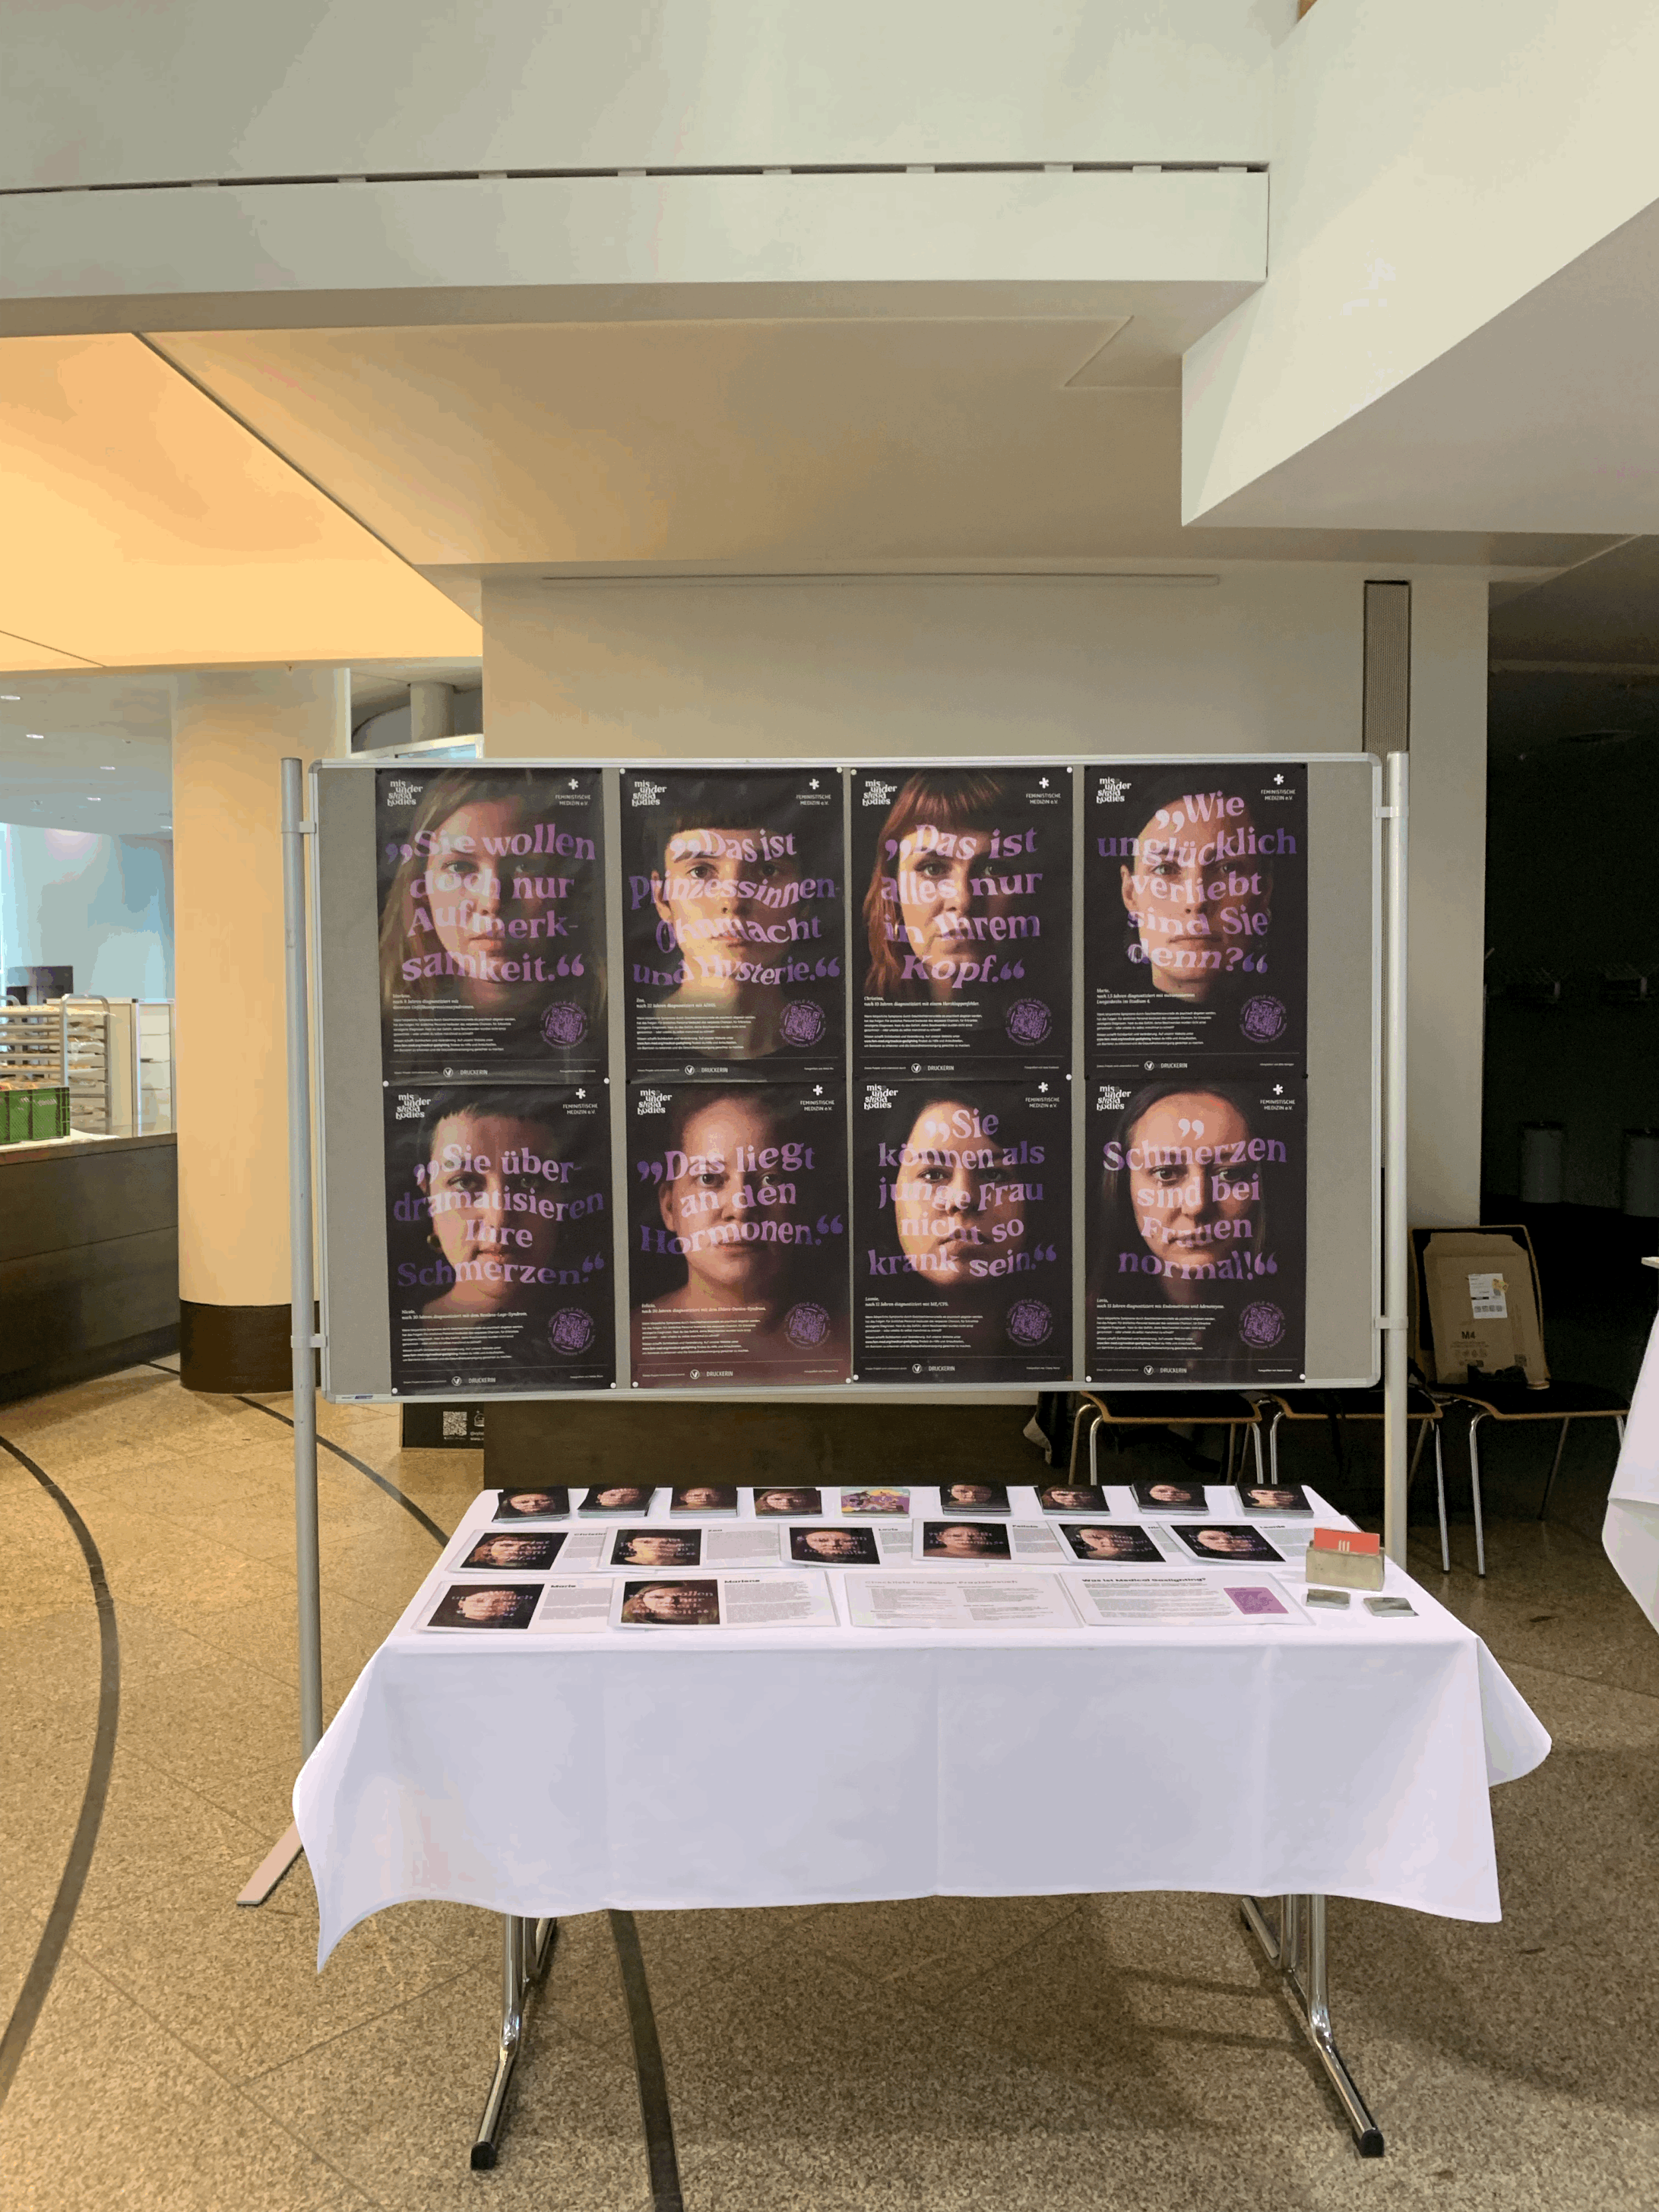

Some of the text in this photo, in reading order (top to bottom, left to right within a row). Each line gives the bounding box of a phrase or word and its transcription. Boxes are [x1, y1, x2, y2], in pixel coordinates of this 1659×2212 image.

[396, 784, 423, 794] under
[640, 784, 667, 794] under
[870, 784, 897, 794] under
[1096, 795, 1125, 804] bodies
[1104, 781, 1131, 791] under
[862, 798, 891, 806] bodies
[1098, 827, 1297, 867] unglücklich
[410, 869, 574, 900] doch nur
[628, 871, 840, 909] Prinzessinnen-
[881, 872, 1043, 905] alles nur
[1131, 871, 1262, 903] verliebt
[407, 900, 578, 938] Aufmerk-
[884, 912, 1041, 943] in Ihrem
[1128, 905, 1269, 936] sind Sie
[656, 916, 822, 953] Ohnmacht
[403, 1098, 431, 1108] under
[645, 1093, 672, 1103] under
[863, 1102, 892, 1110] bodies
[871, 1088, 899, 1098] under
[1104, 1089, 1131, 1100] under
[396, 1111, 425, 1120] bodies
[637, 1106, 666, 1115] bodies
[879, 1141, 1045, 1170] können als
[1103, 1138, 1287, 1171] Schmerzen
[394, 1186, 603, 1221] dramatisieren
[680, 1183, 796, 1218] an den
[878, 1177, 1044, 1211] junge Frau
[1137, 1173, 1260, 1209] sind bei
[465, 1219, 533, 1248] Ihre
[901, 1216, 1024, 1245] nicht so
[1141, 1215, 1253, 1248] Frauen
[1462, 1331, 1475, 1339] M4
